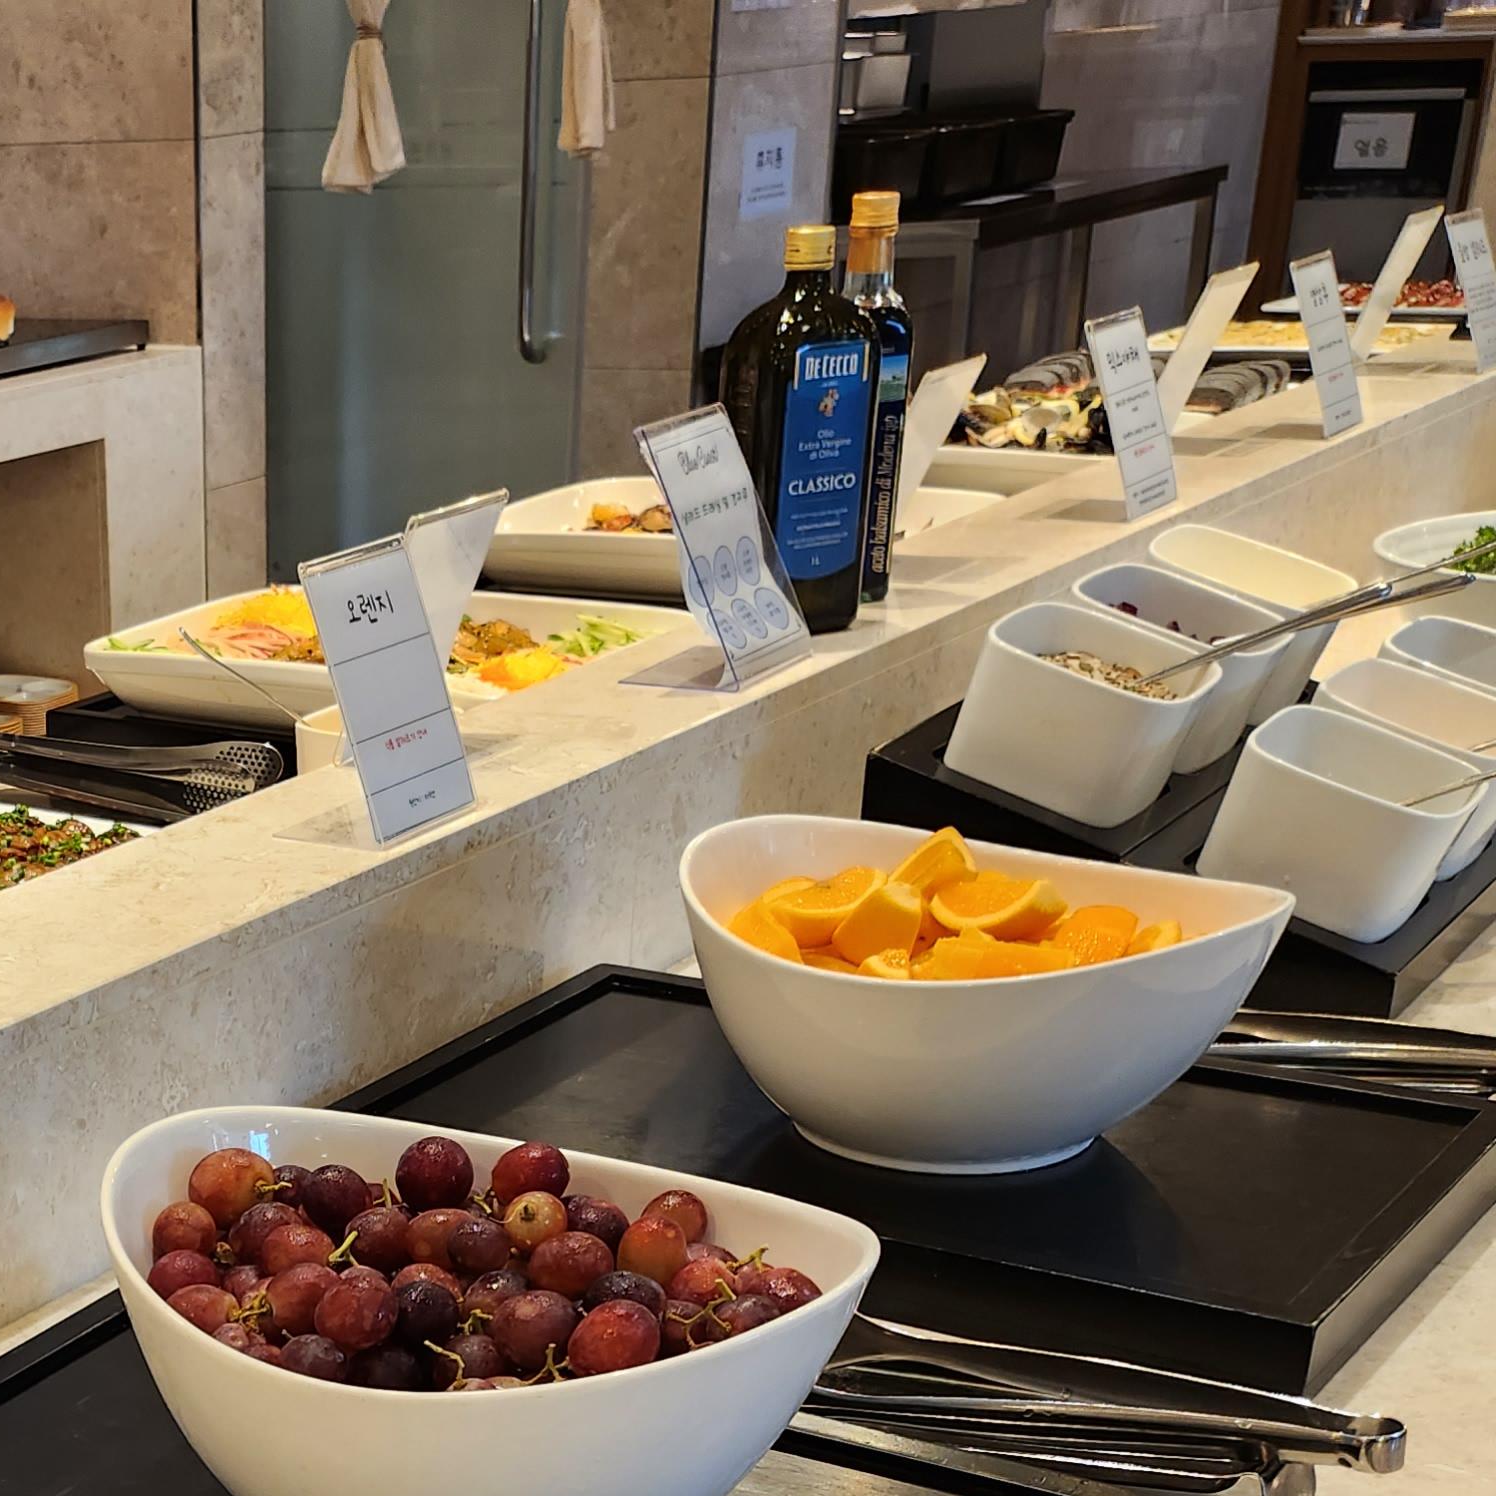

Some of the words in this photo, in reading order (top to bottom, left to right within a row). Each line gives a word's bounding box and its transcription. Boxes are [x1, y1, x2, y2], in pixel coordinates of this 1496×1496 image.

[788, 473, 857, 496] CLASSICO
[870, 490, 891, 545] balsamico
[347, 590, 394, 624] 오렌지
